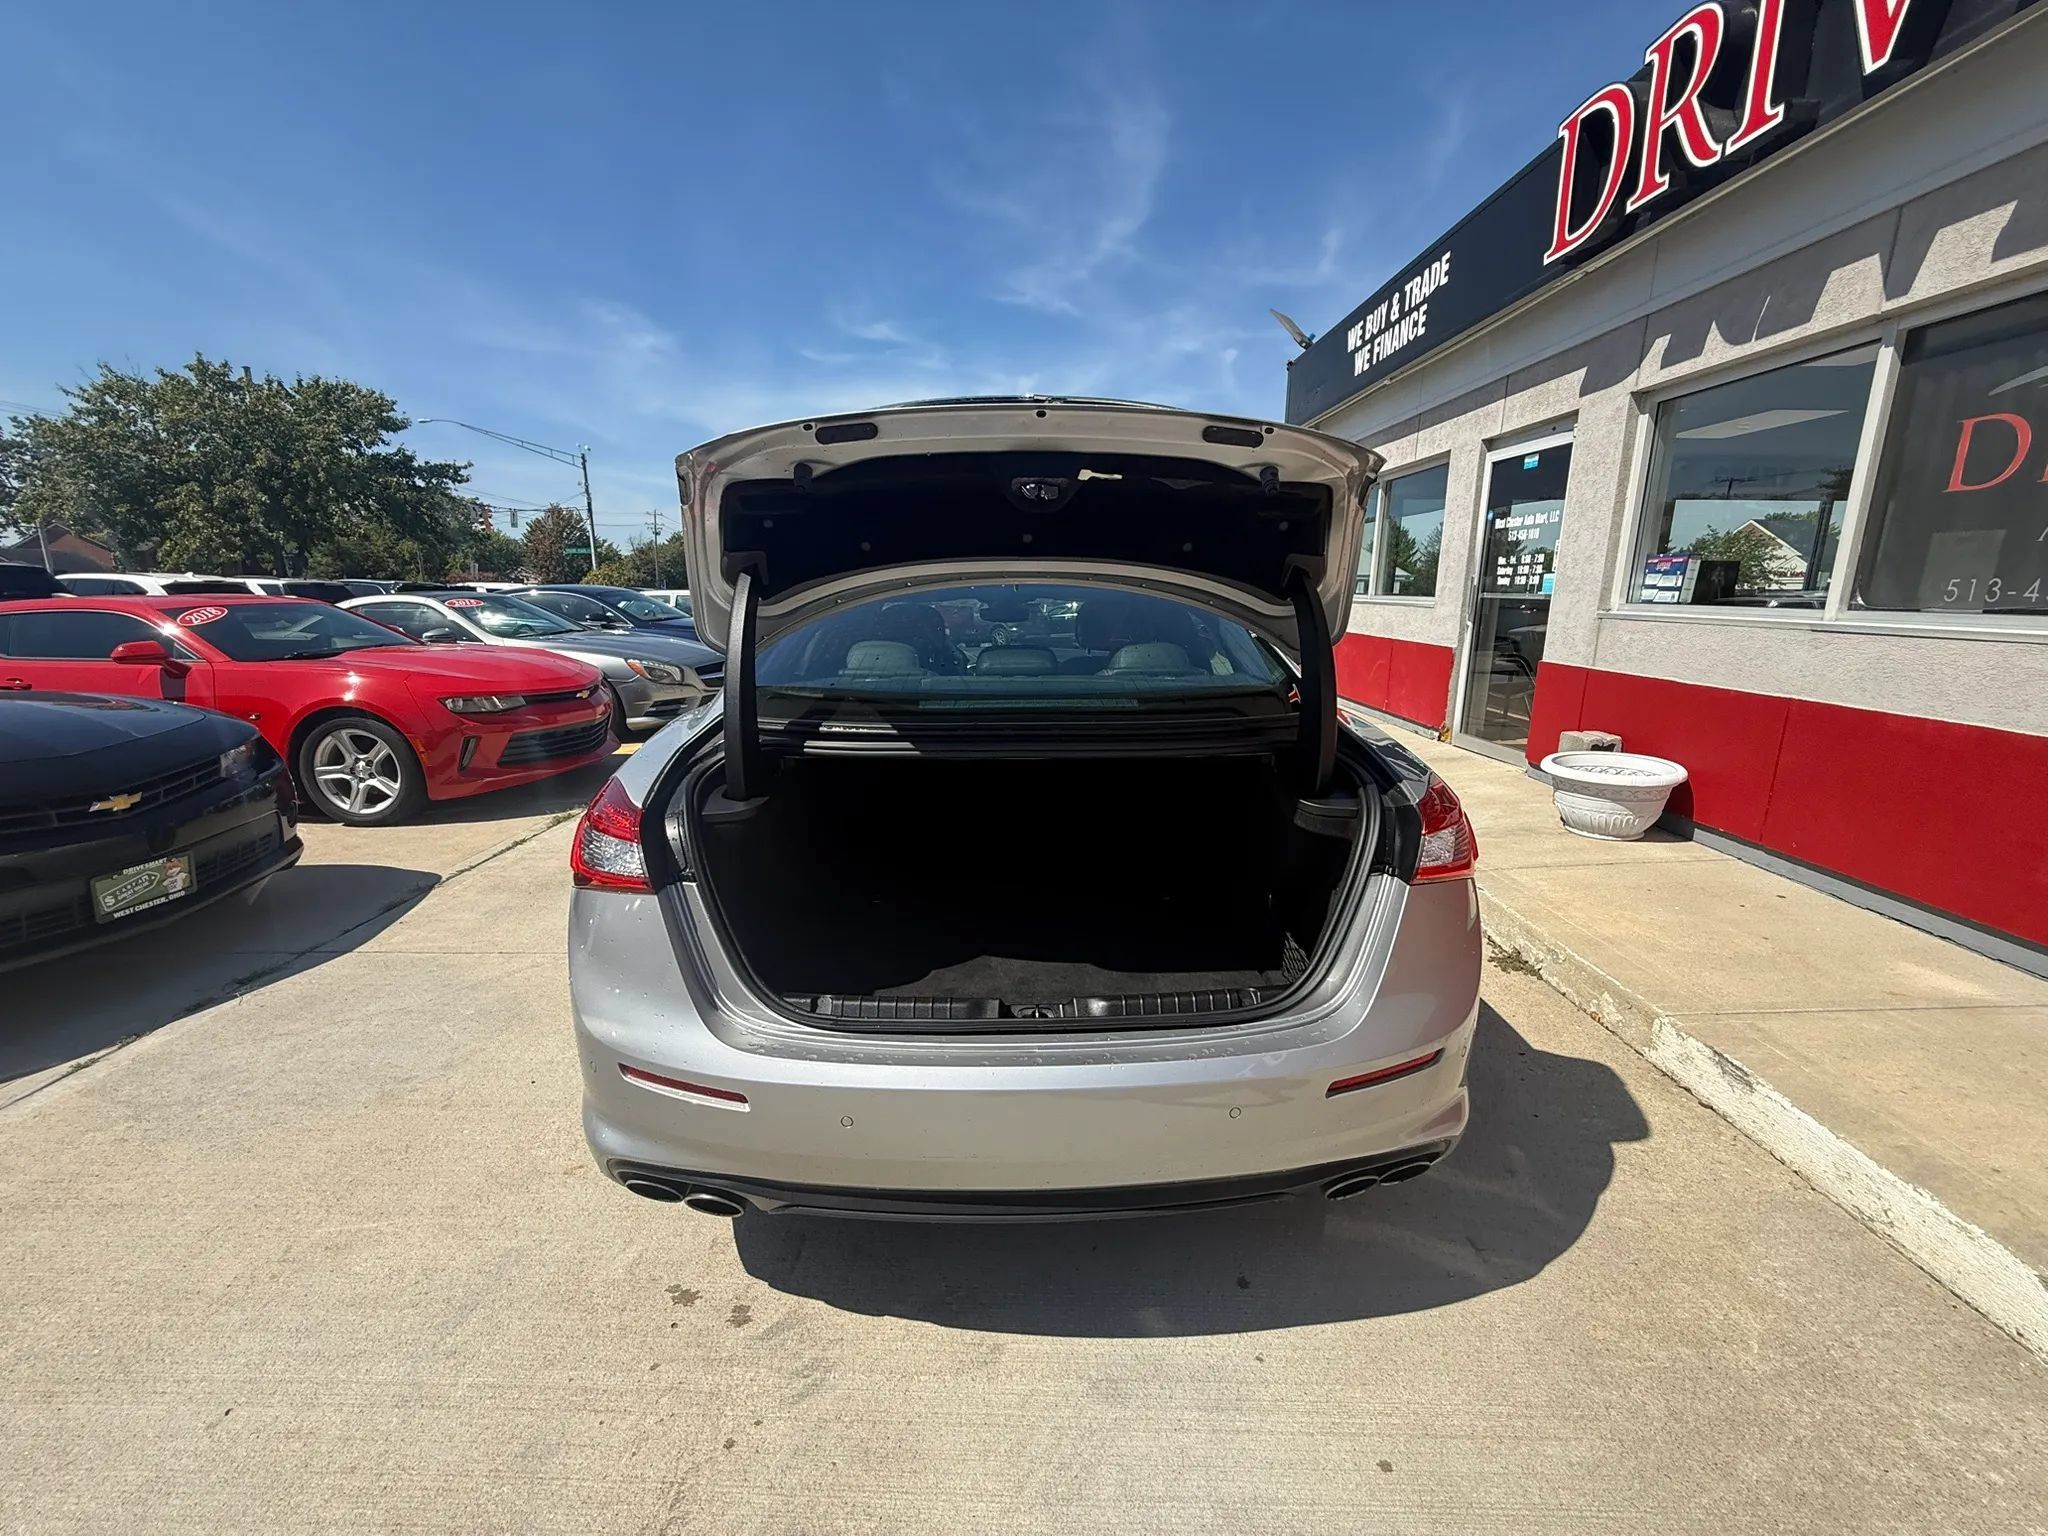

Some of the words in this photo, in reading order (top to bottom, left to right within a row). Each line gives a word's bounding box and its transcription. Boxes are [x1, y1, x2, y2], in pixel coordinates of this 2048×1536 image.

[1347, 320, 1364, 353] WE
[1364, 299, 1389, 341] BUY
[1390, 292, 1400, 322] &
[1404, 250, 1451, 312] TRADE
[1354, 343, 1371, 377] WE
[1372, 303, 1428, 365] FINANCE
[1942, 413, 2048, 493] D
[1549, 509, 1560, 523] LLC
[1943, 578, 2048, 602] 513-4
[185, 607, 222, 625] 2018
[123, 857, 167, 875] DRIVESMART
[113, 907, 134, 919] WEST
[135, 897, 169, 912] CHESTER,
[169, 890, 186, 902] OHIO
